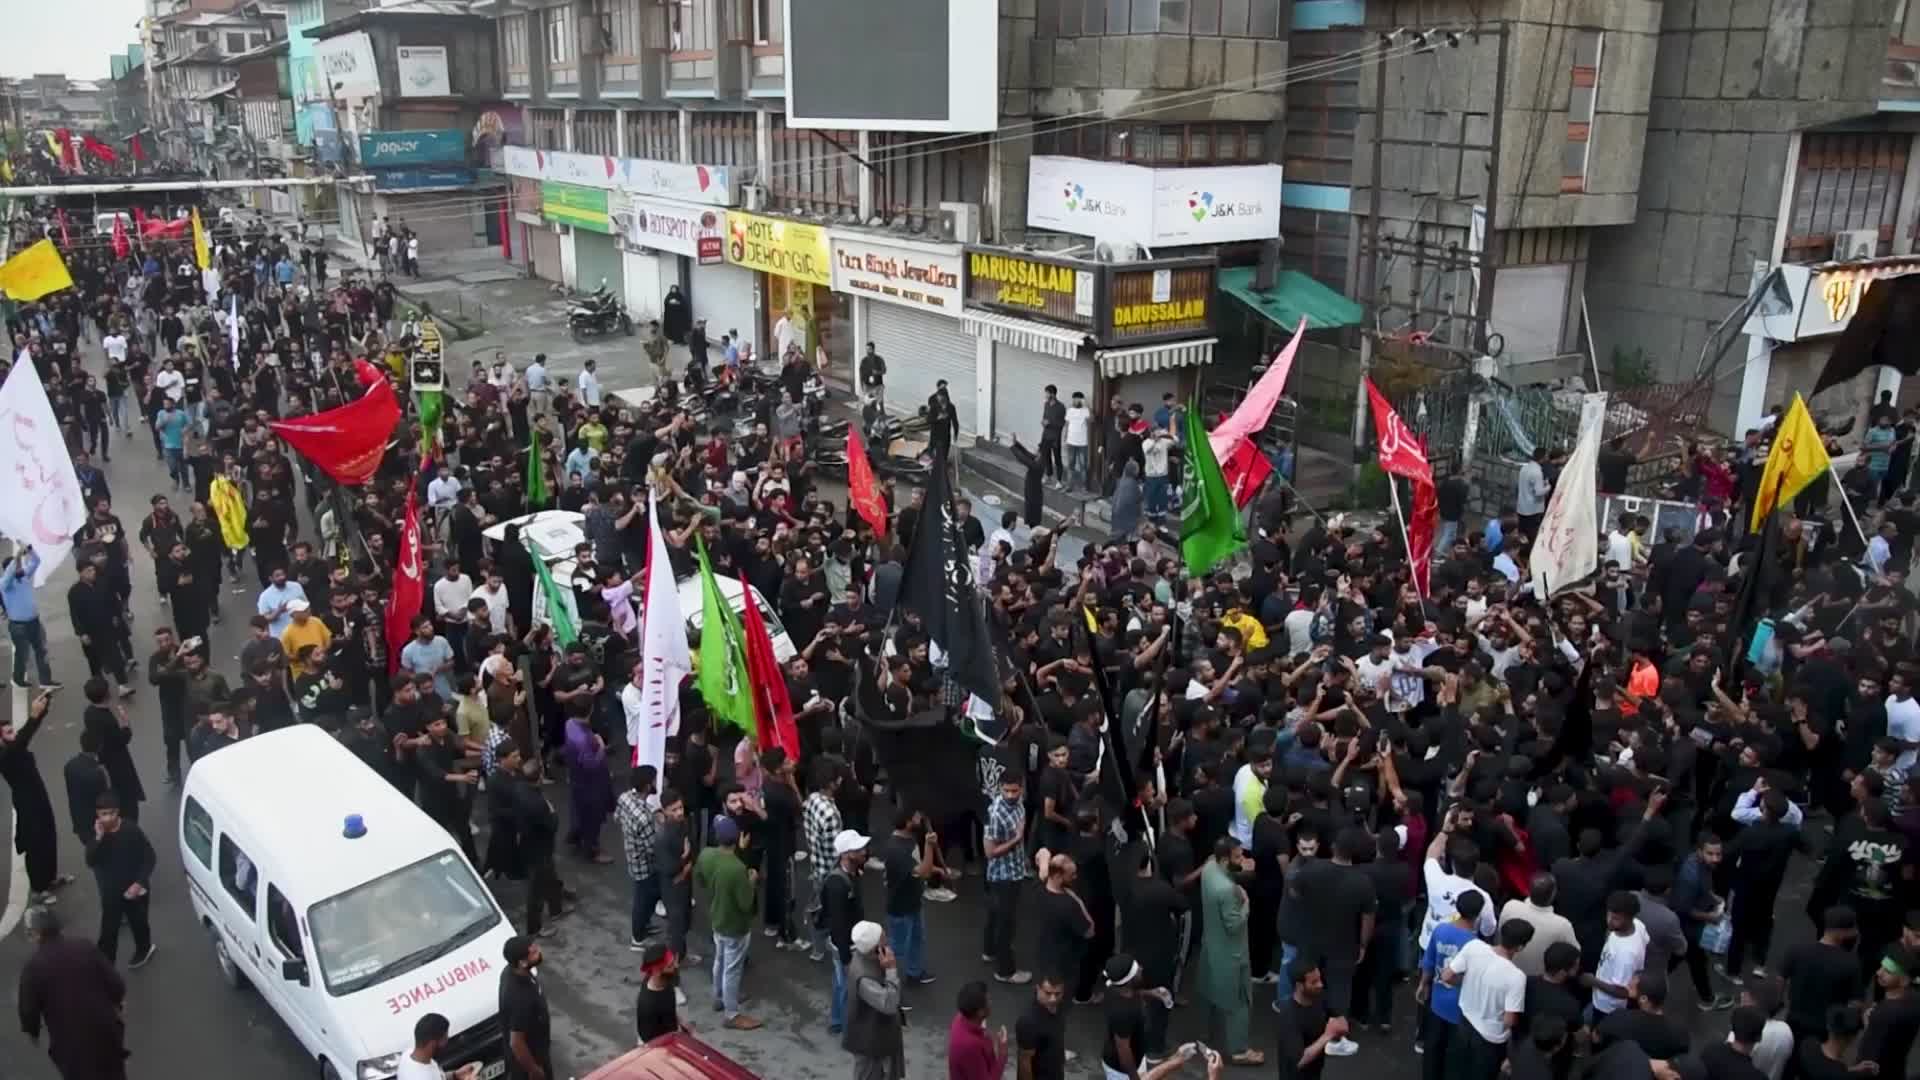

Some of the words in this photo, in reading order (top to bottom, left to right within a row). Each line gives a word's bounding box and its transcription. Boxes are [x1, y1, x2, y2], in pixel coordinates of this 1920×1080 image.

[1211, 203, 1235, 217] J&K
[1238, 201, 1264, 216] Bank
[650, 213, 688, 240] HOTSPOT
[702, 241, 721, 251] ATM
[971, 253, 1073, 293] DARUSSALAM
[1114, 297, 1206, 326] DARUSSALAM
